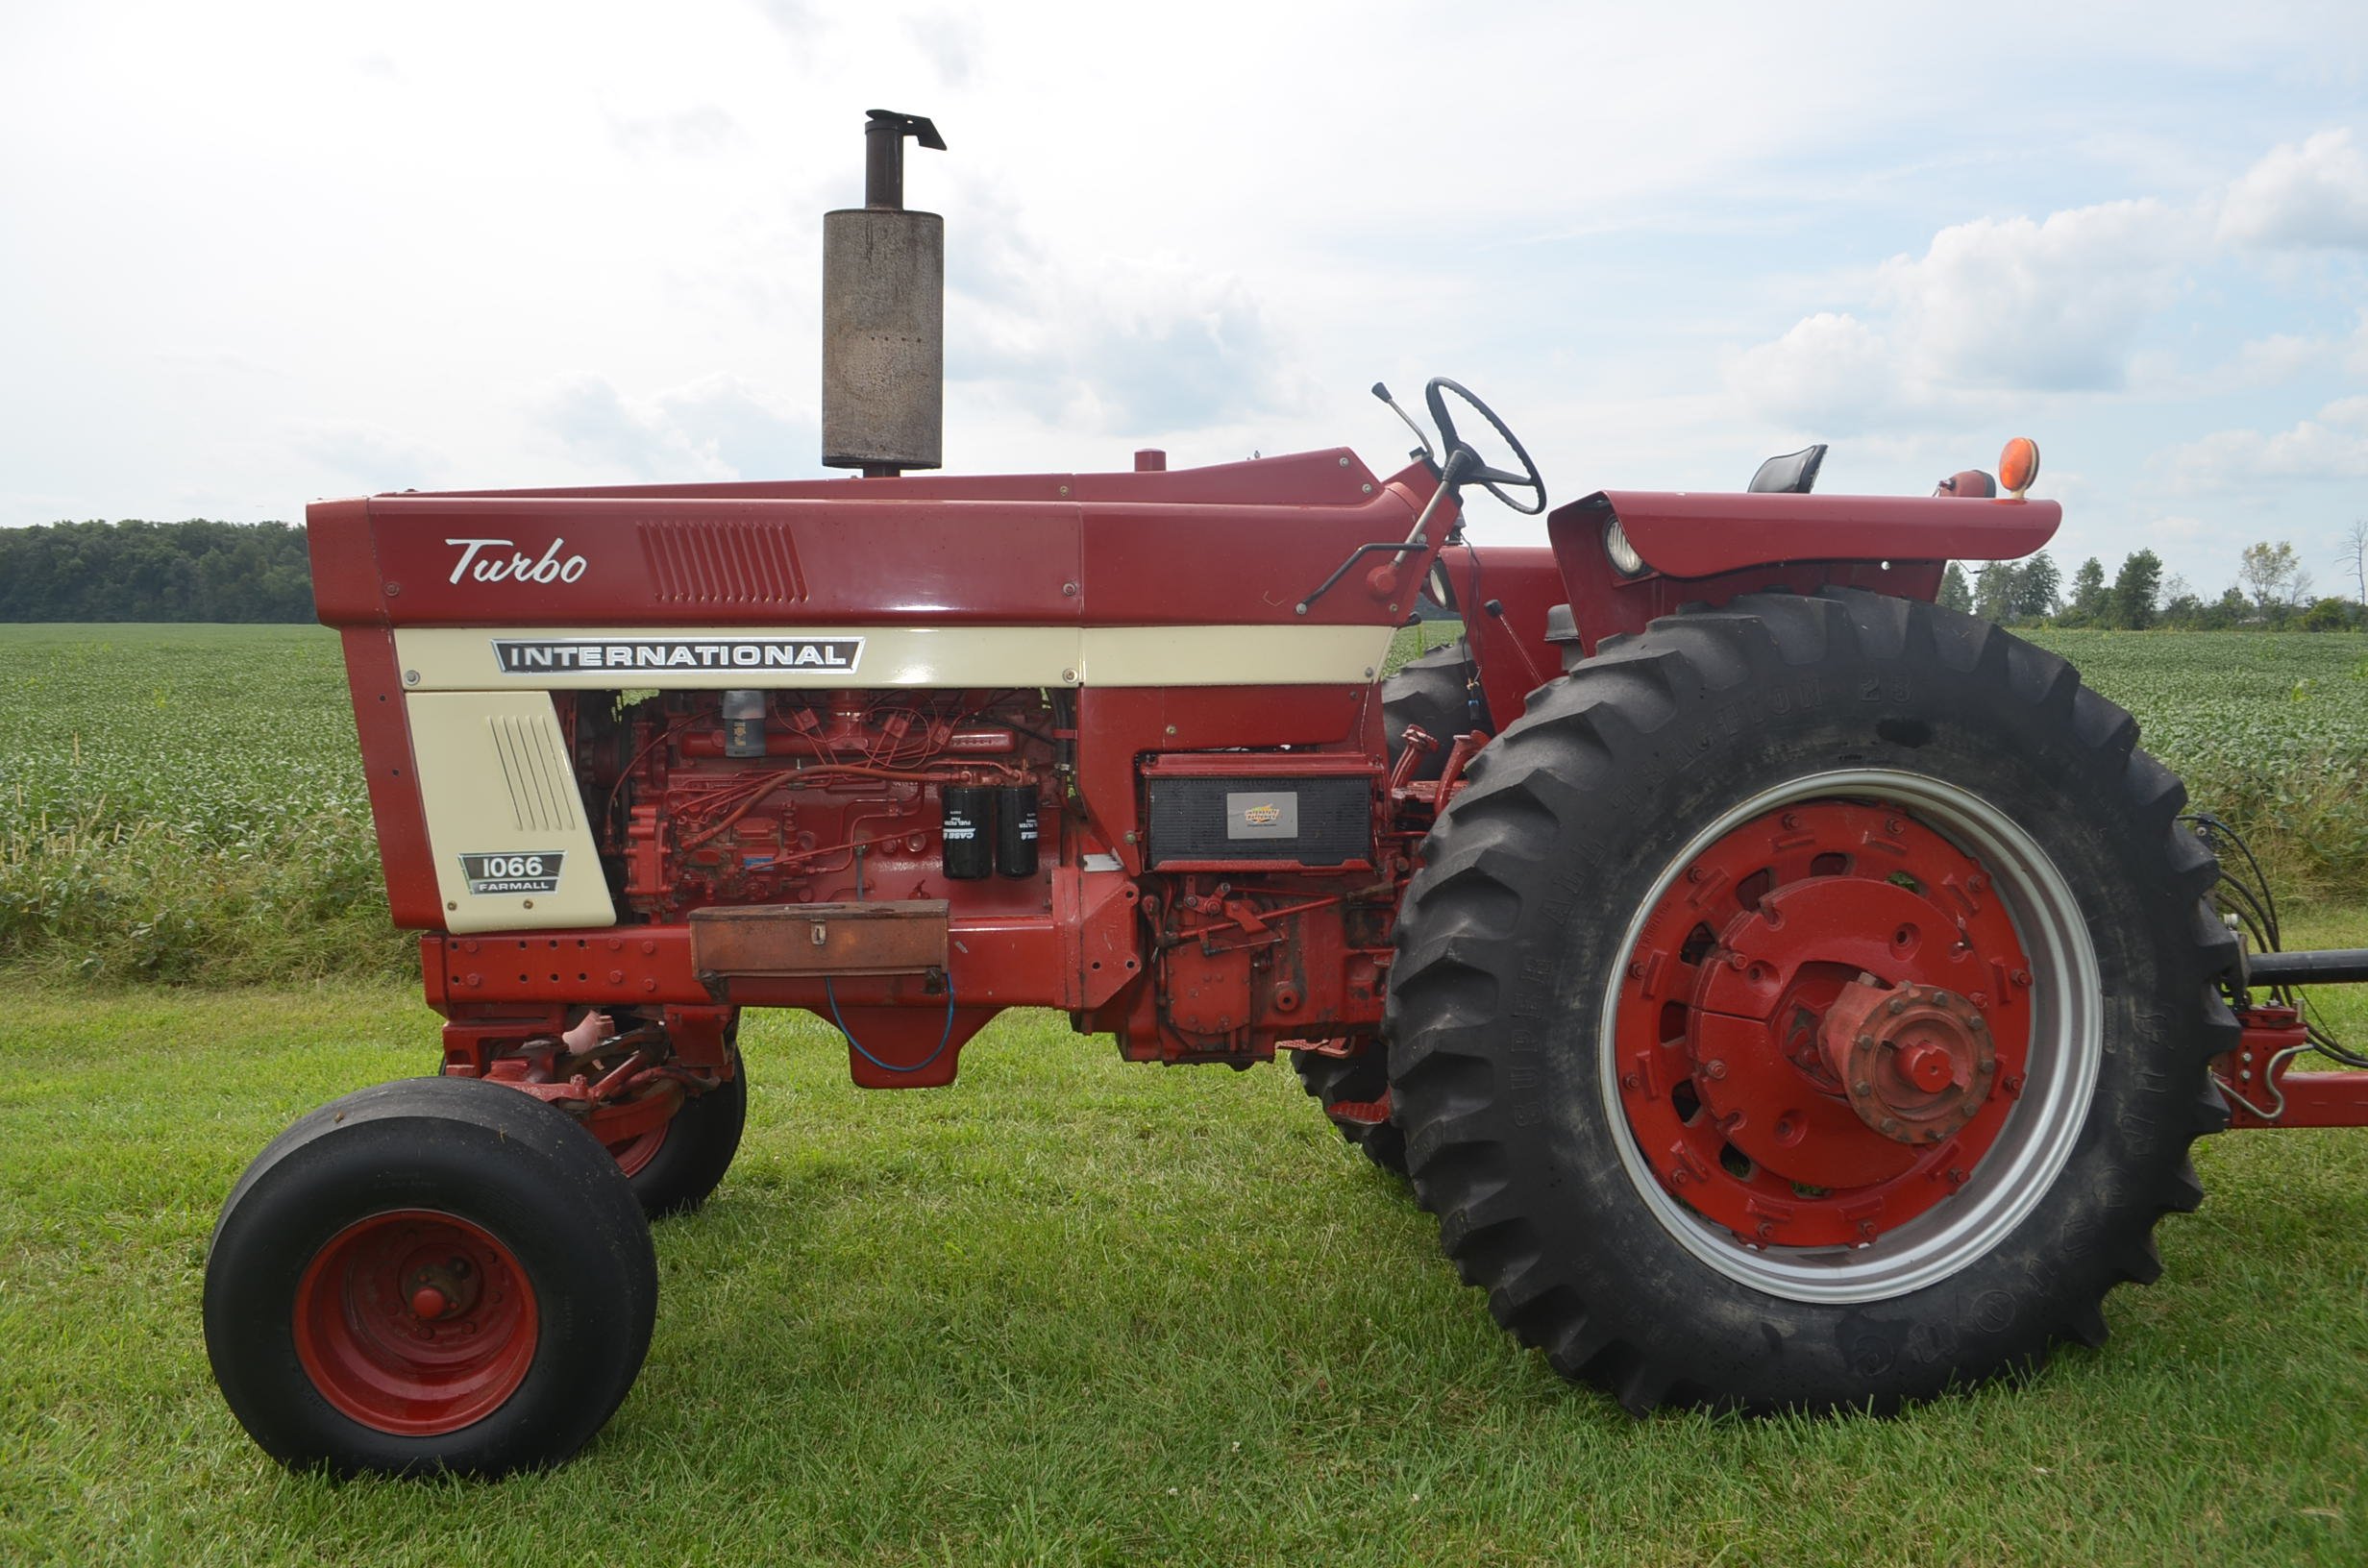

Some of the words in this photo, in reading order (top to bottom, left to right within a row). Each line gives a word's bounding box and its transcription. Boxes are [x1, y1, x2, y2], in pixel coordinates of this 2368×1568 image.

[445, 538, 587, 585] Turbo
[511, 646, 847, 666] INTERNATIONAL
[482, 856, 543, 878] 1066
[479, 881, 550, 892] FARMALL
[1538, 835, 1607, 927] ALL
